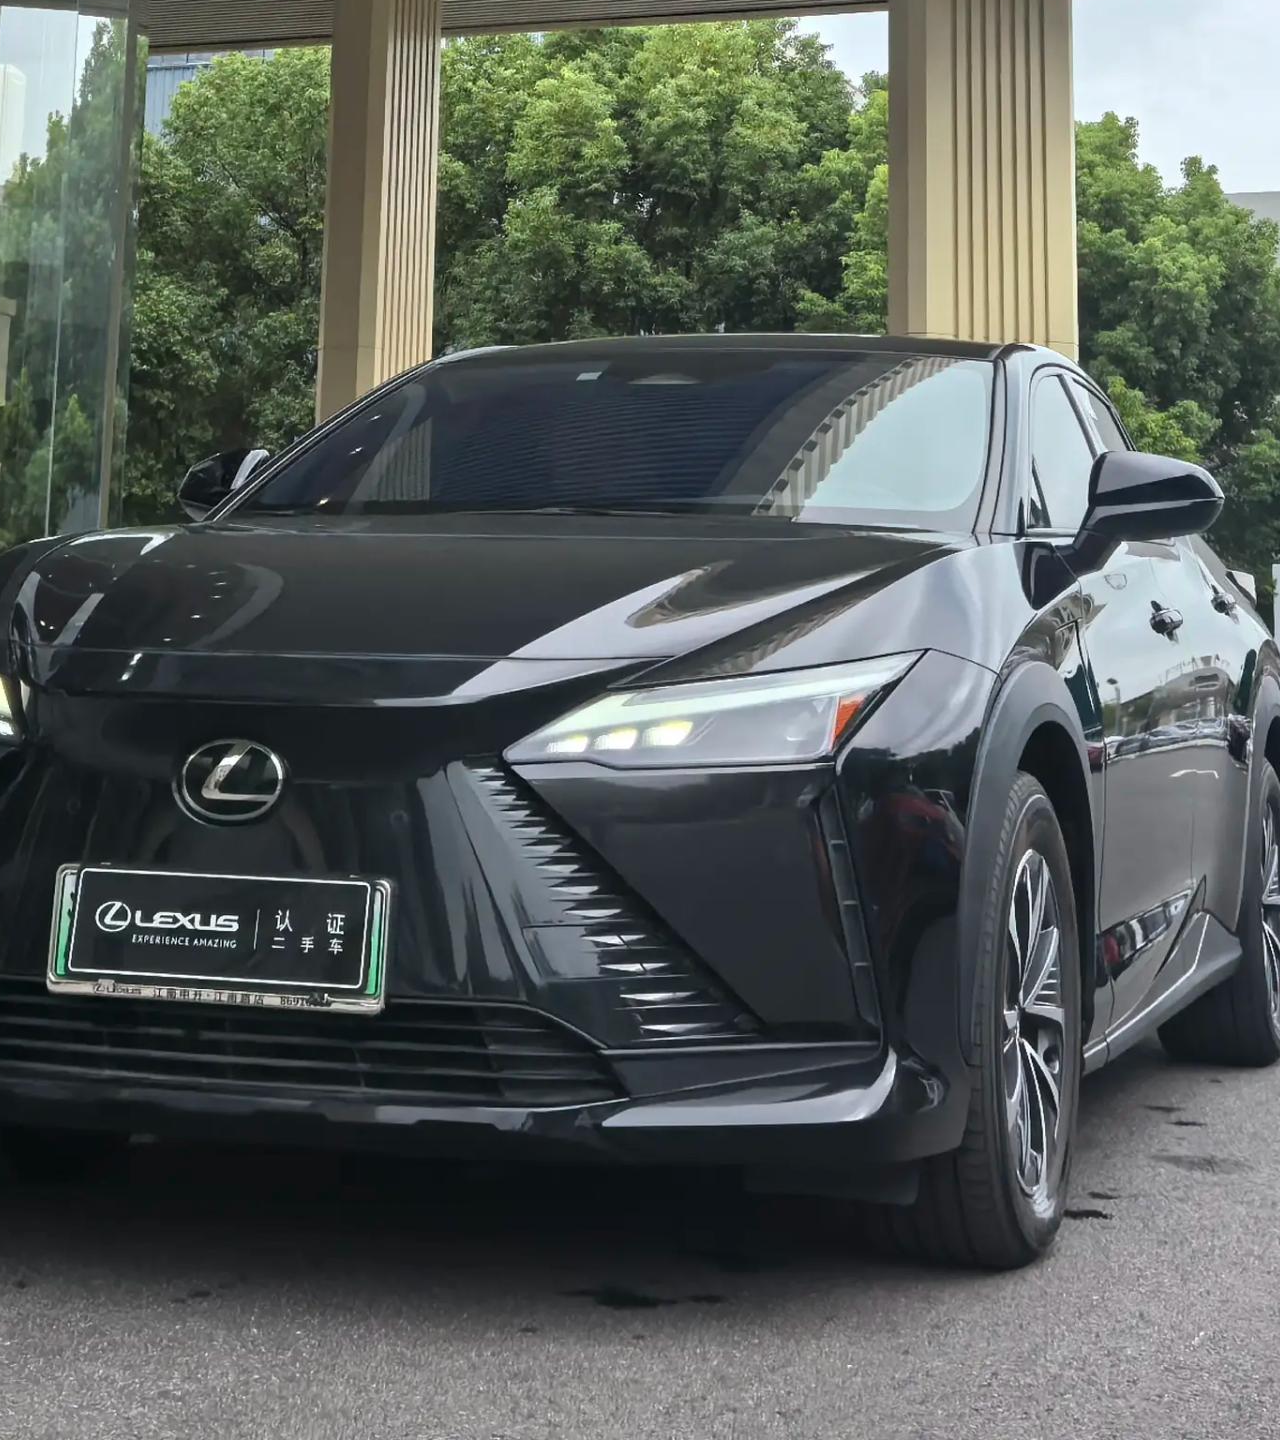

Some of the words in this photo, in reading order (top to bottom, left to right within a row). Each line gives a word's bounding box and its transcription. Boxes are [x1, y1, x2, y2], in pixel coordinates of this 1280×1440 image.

[135, 910, 240, 932] LEXUS
[274, 909, 346, 936] 认证
[131, 933, 190, 946] EXPERIENCE
[192, 937, 237, 949] AMAZING
[271, 936, 344, 955] 二手车
